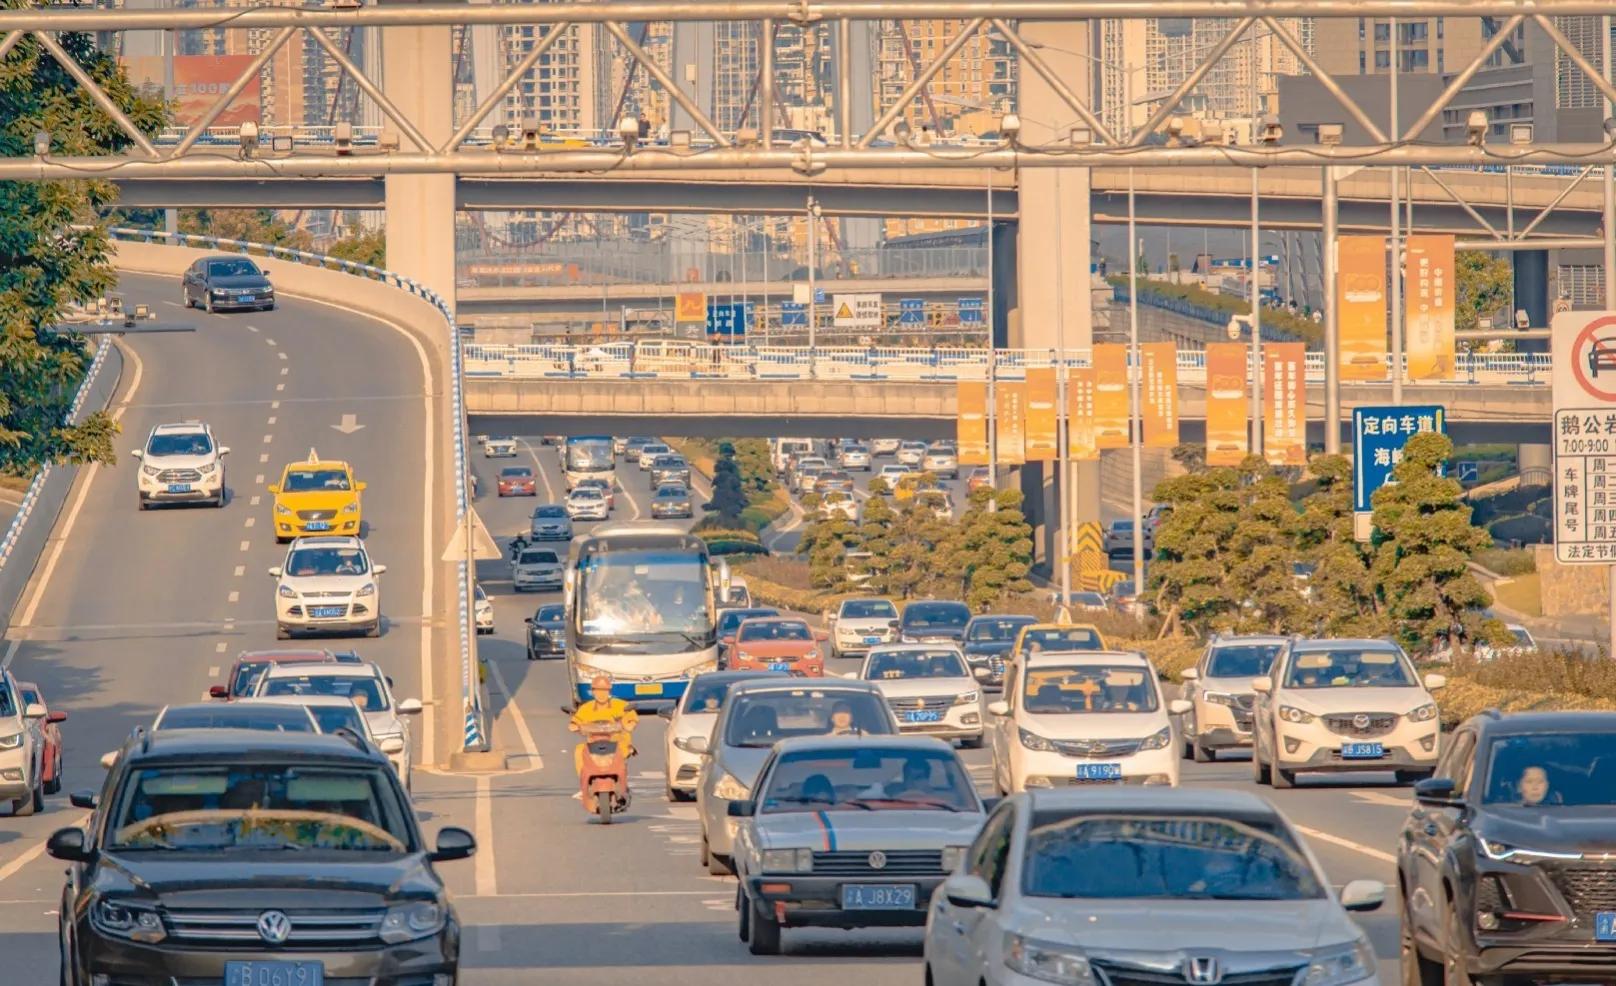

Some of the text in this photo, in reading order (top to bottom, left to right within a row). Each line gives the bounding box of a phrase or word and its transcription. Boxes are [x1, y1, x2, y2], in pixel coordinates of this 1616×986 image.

[1363, 415, 1434, 435] 定向车道
[1561, 413, 1616, 435] 鹅公岩
[1593, 458, 1616, 472] 周一
[1594, 474, 1616, 488] 周二
[1564, 467, 1579, 532] 车牌尾号
[1594, 491, 1616, 505] 周三
[1594, 508, 1616, 522] 周四
[1594, 525, 1616, 539] 周五
